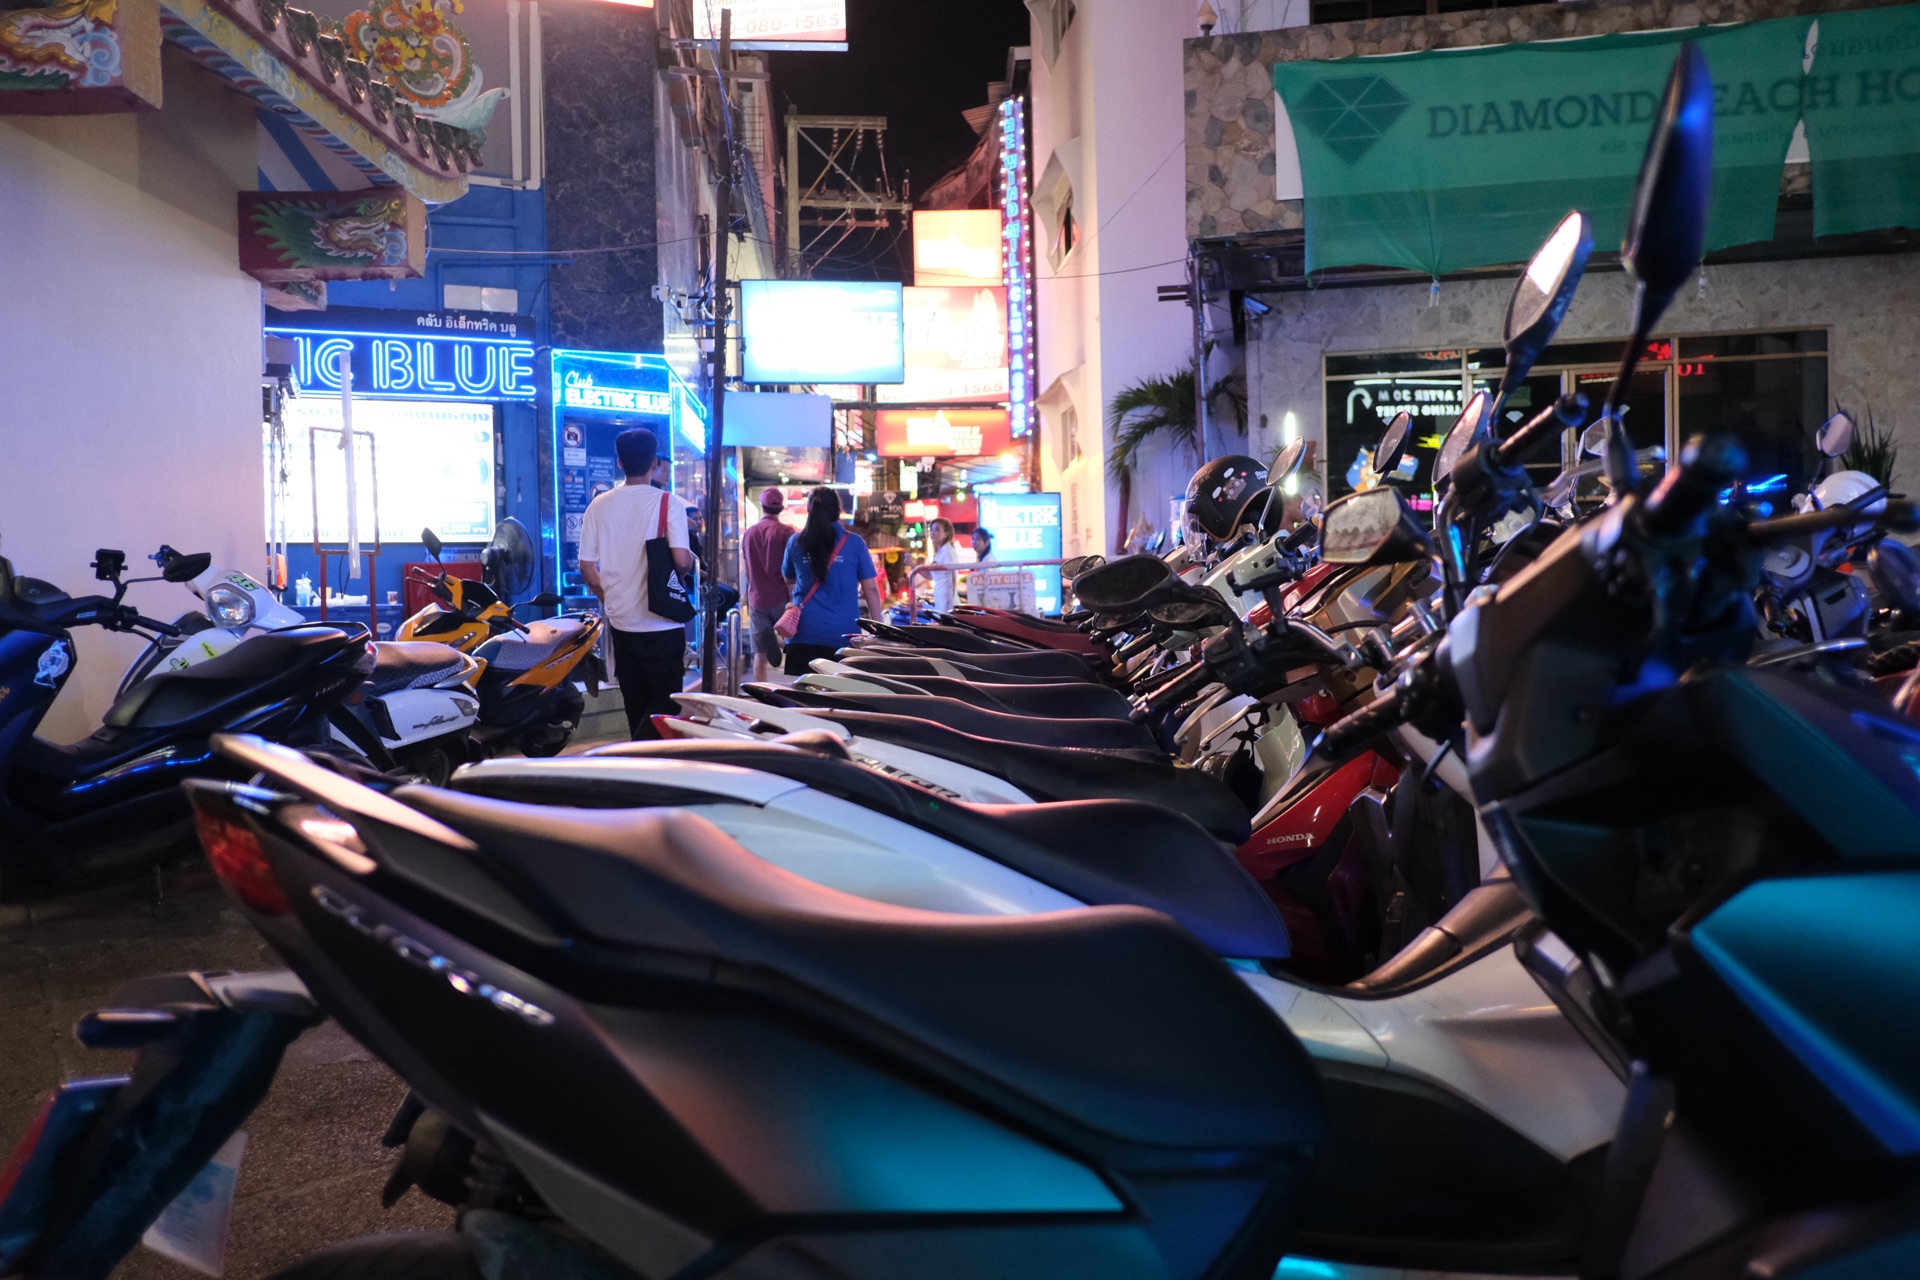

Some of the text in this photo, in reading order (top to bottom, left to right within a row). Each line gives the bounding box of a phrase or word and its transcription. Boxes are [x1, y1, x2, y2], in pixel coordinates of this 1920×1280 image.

[1427, 90, 1658, 140] DIAMOND
[1713, 74, 1842, 118] EACH
[1002, 100, 1016, 149] THE
[1003, 153, 1021, 284] WINDMILL
[416, 313, 442, 328] คลับ
[500, 323, 517, 338] บลู
[372, 339, 537, 395] BLUE
[565, 370, 593, 388] Club
[565, 387, 635, 408] ELECTRIC
[981, 505, 1059, 527] LECTRIC
[997, 528, 1044, 549] LUE
[225, 575, 260, 592] 46
[972, 574, 1002, 585] PARTY
[1266, 832, 1314, 845] HONDA
